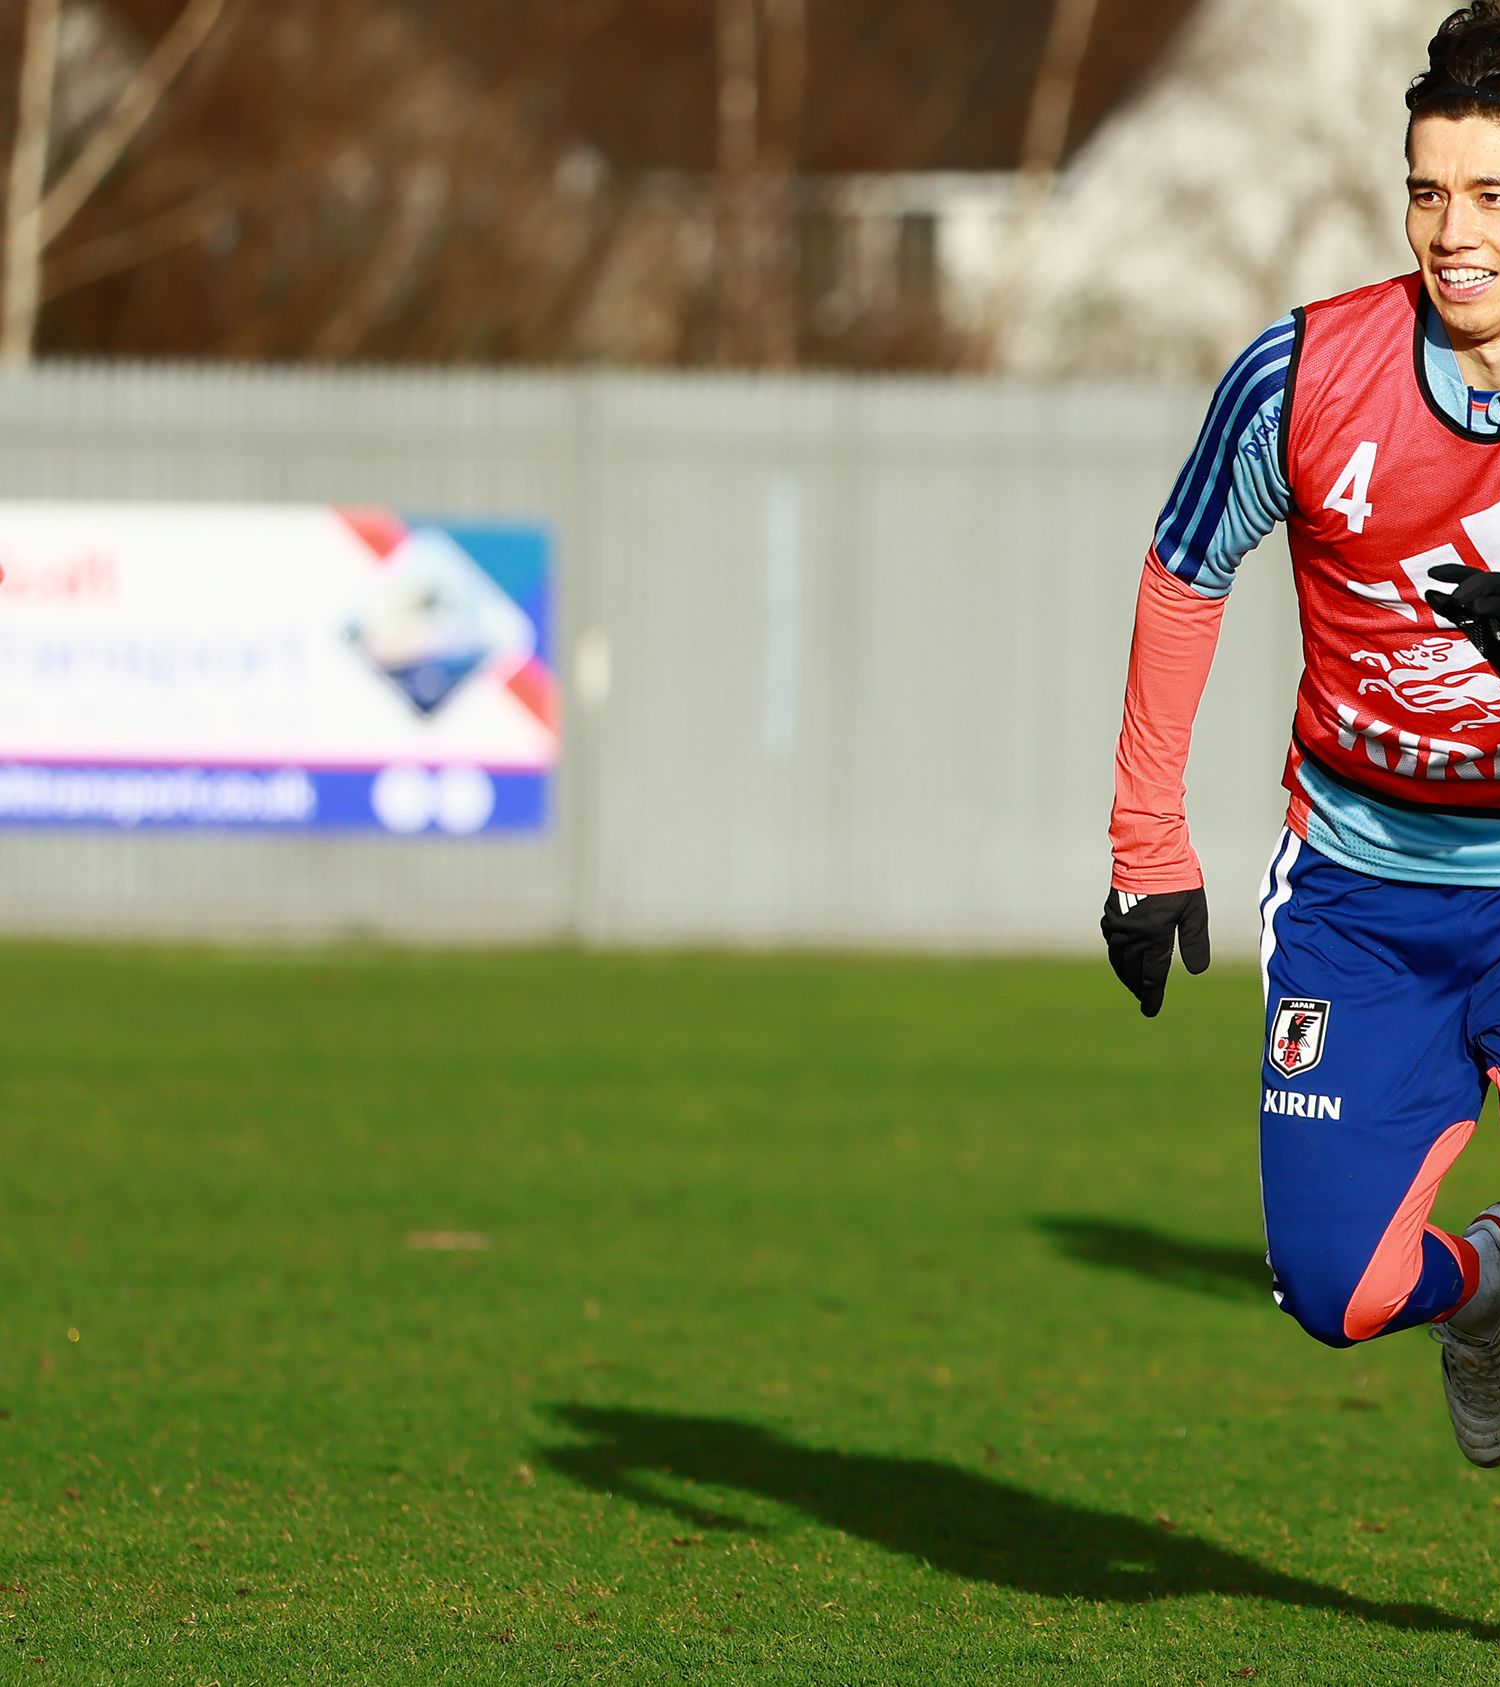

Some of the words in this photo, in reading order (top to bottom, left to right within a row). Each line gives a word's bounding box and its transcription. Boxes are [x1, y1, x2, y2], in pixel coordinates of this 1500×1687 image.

[1322, 441, 1378, 534] 4
[1280, 1050, 1302, 1063] JFA
[1263, 1089, 1342, 1121] KIRIN
